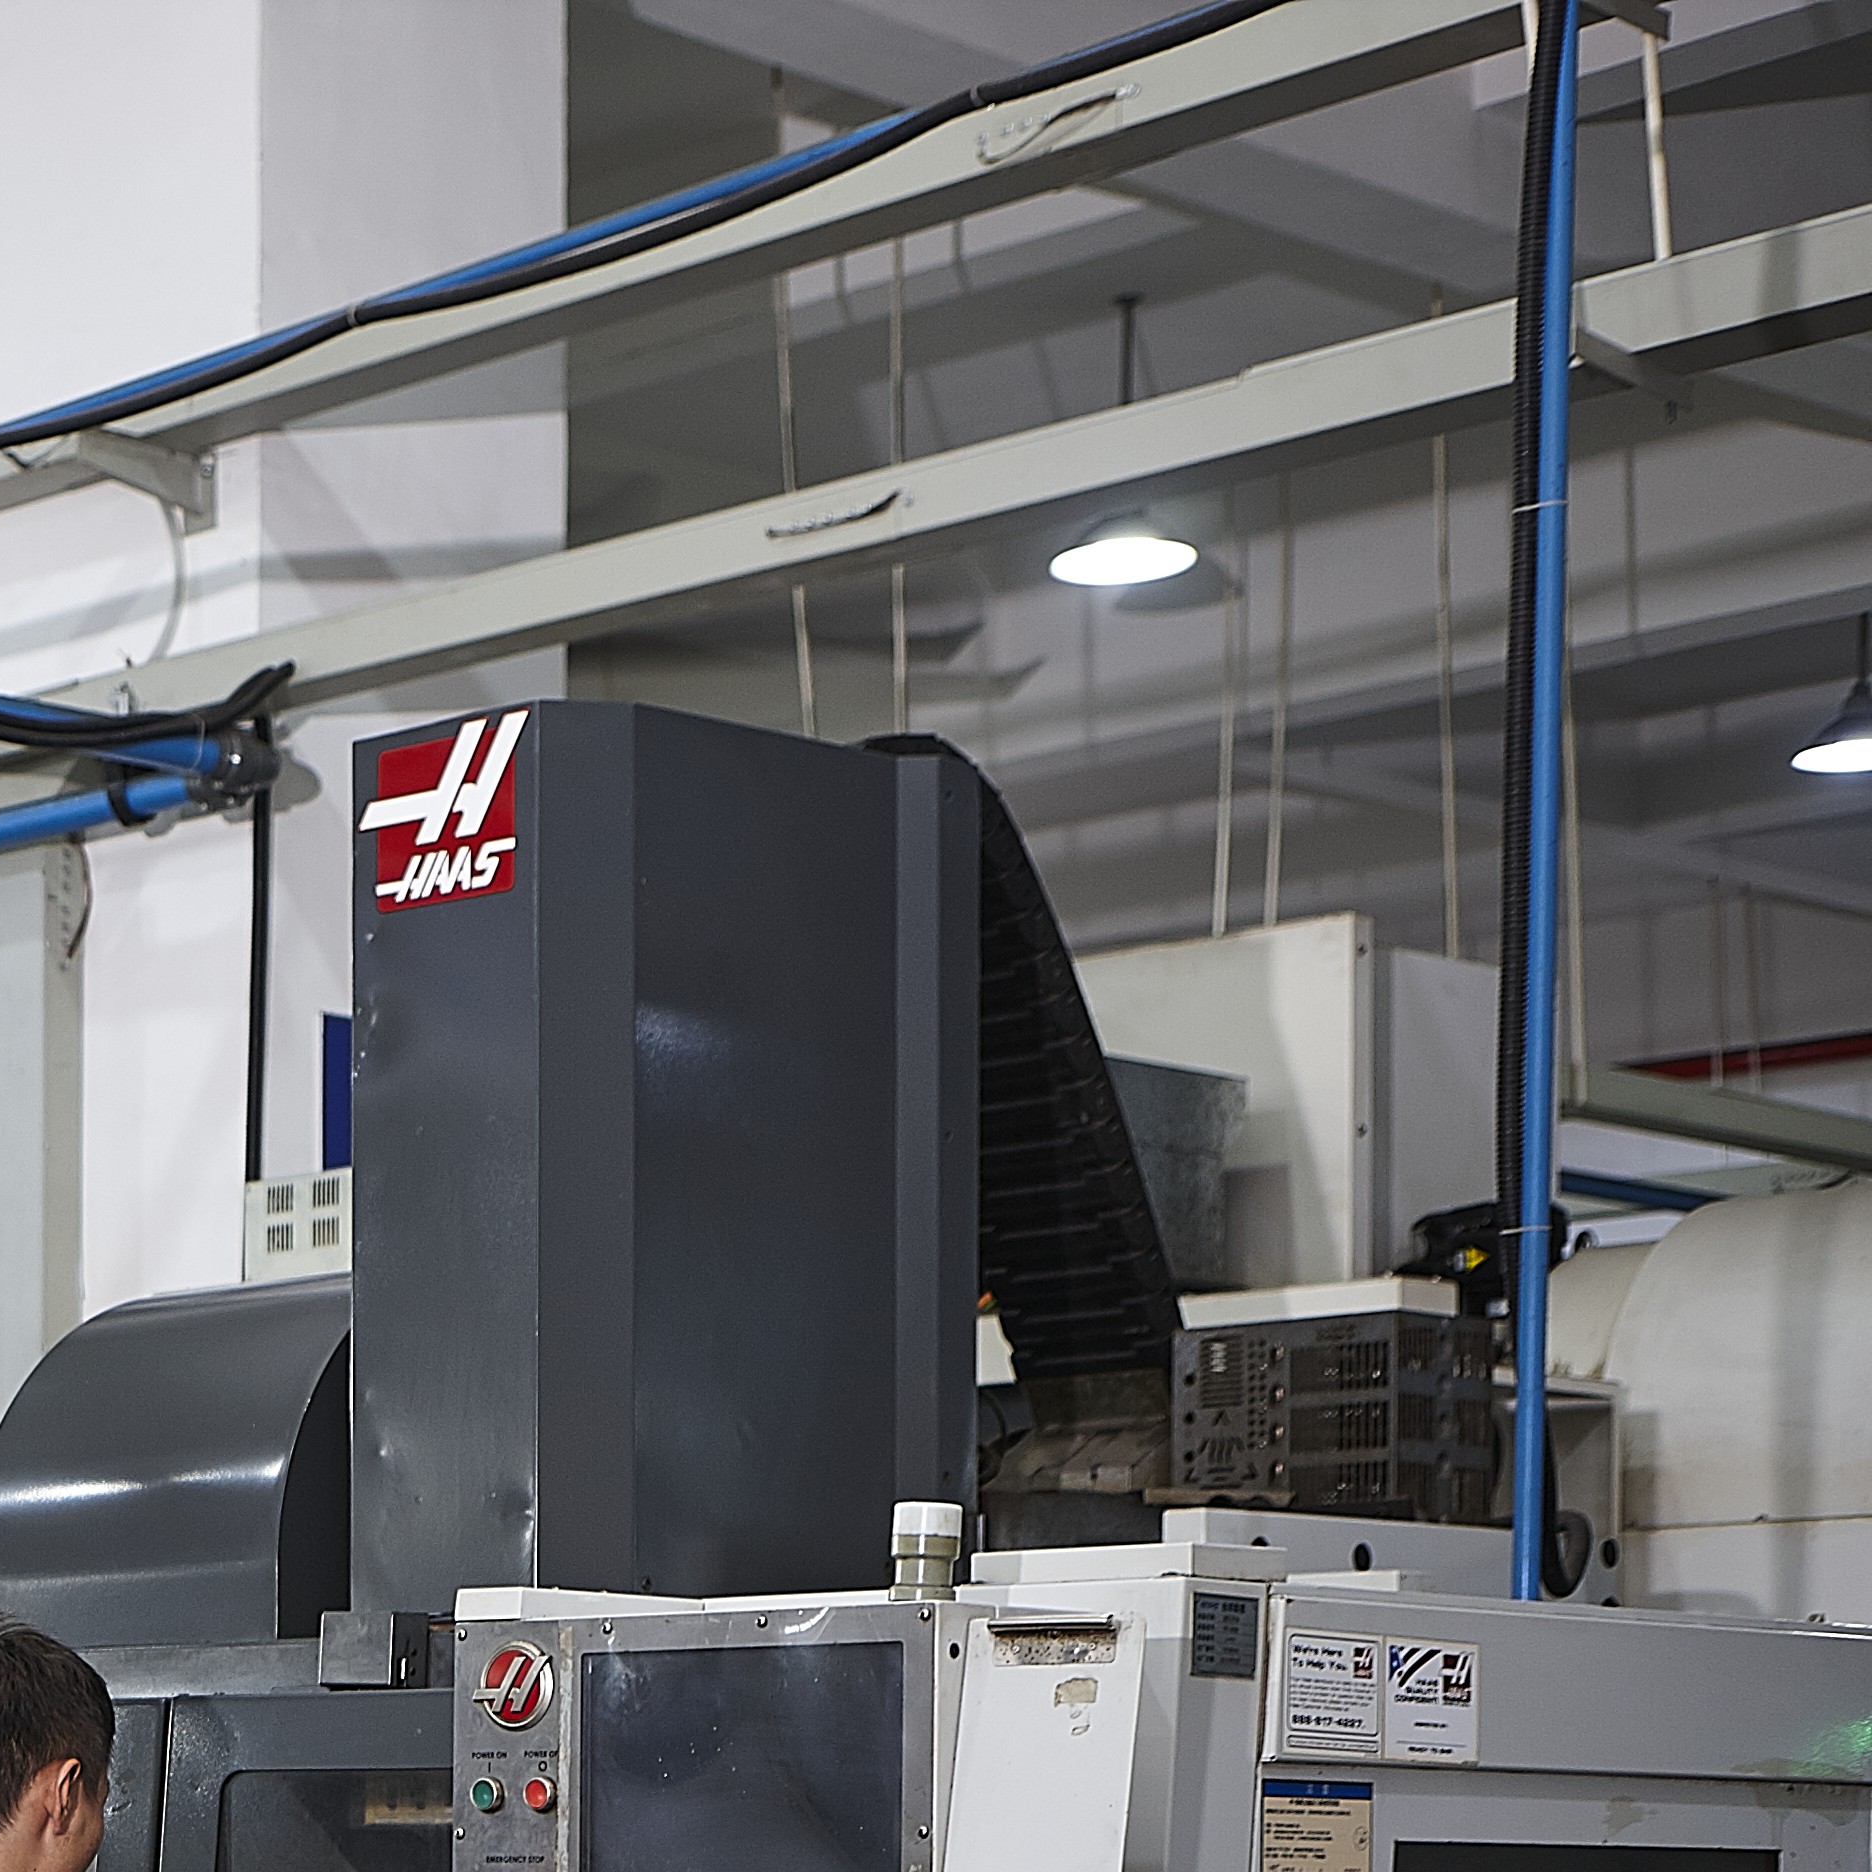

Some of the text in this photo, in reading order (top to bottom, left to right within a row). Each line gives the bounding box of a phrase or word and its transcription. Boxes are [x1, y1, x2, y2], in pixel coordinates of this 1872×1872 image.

[375, 836, 517, 904] HAAS
[471, 1751, 507, 1759] POWER ON
[523, 1750, 547, 1758] POWER
[486, 1855, 546, 1864] EMERGENCY STOP
